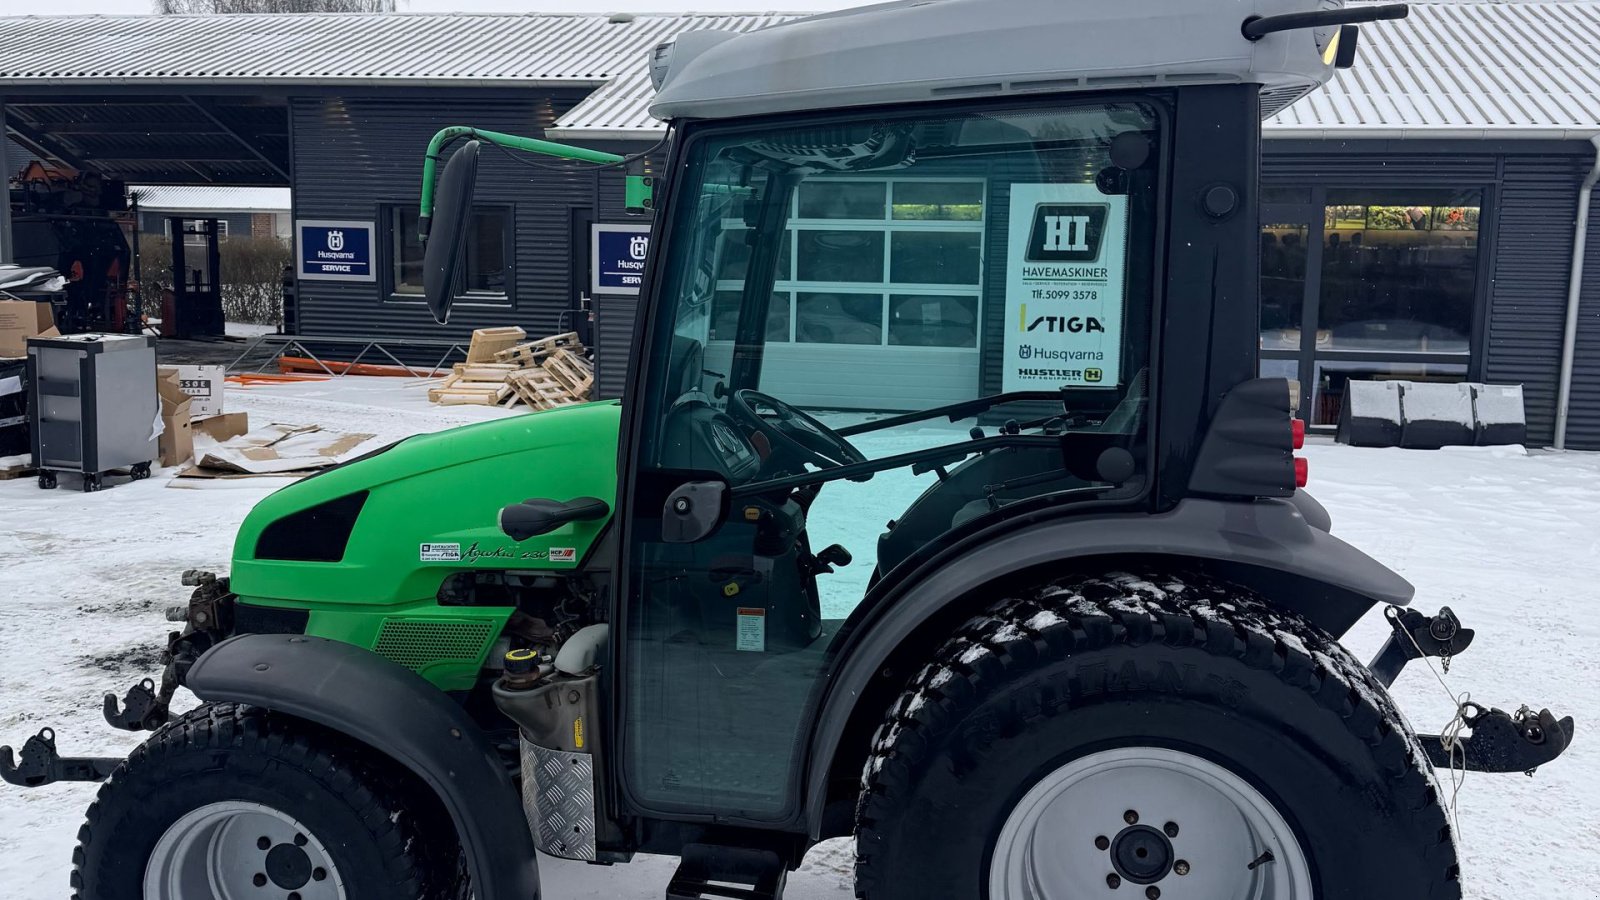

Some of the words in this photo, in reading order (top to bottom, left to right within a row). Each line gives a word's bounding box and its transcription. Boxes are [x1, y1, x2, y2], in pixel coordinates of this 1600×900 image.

[1043, 215, 1090, 251] HI
[317, 250, 355, 260] Husqvarna
[322, 264, 351, 272] SERVICE
[617, 259, 645, 270] Husqv
[1022, 266, 1108, 278] HAVEMASKINER
[622, 276, 642, 284] SERV
[1072, 290, 1097, 300] 3578
[1027, 316, 1105, 333] STIGA
[1034, 347, 1104, 362] Husqvarna
[1018, 368, 1082, 377] HUSTLER
[520, 551, 549, 560] 230
